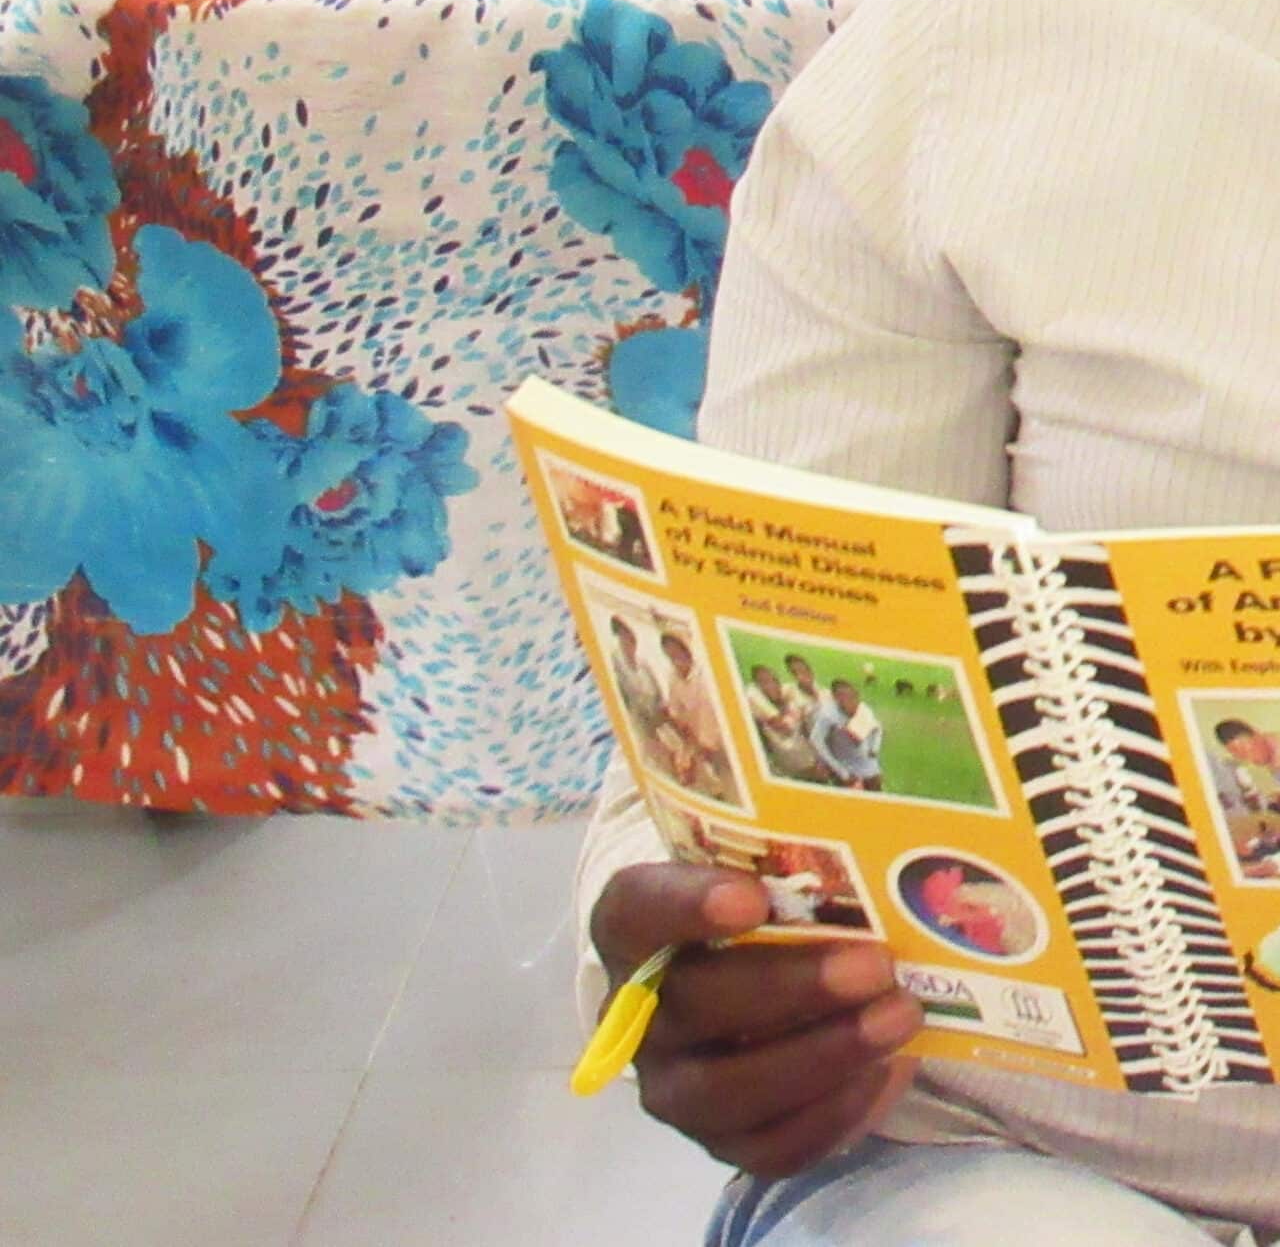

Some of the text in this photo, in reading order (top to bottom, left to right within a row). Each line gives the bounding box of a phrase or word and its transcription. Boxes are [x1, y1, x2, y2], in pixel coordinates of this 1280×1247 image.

[660, 499, 877, 556] A Field Manual
[666, 526, 946, 590] of Animal Diseases
[672, 549, 880, 604] by Syndromes
[1207, 560, 1243, 582] A
[1166, 591, 1213, 613] of
[1180, 657, 1224, 673] With
